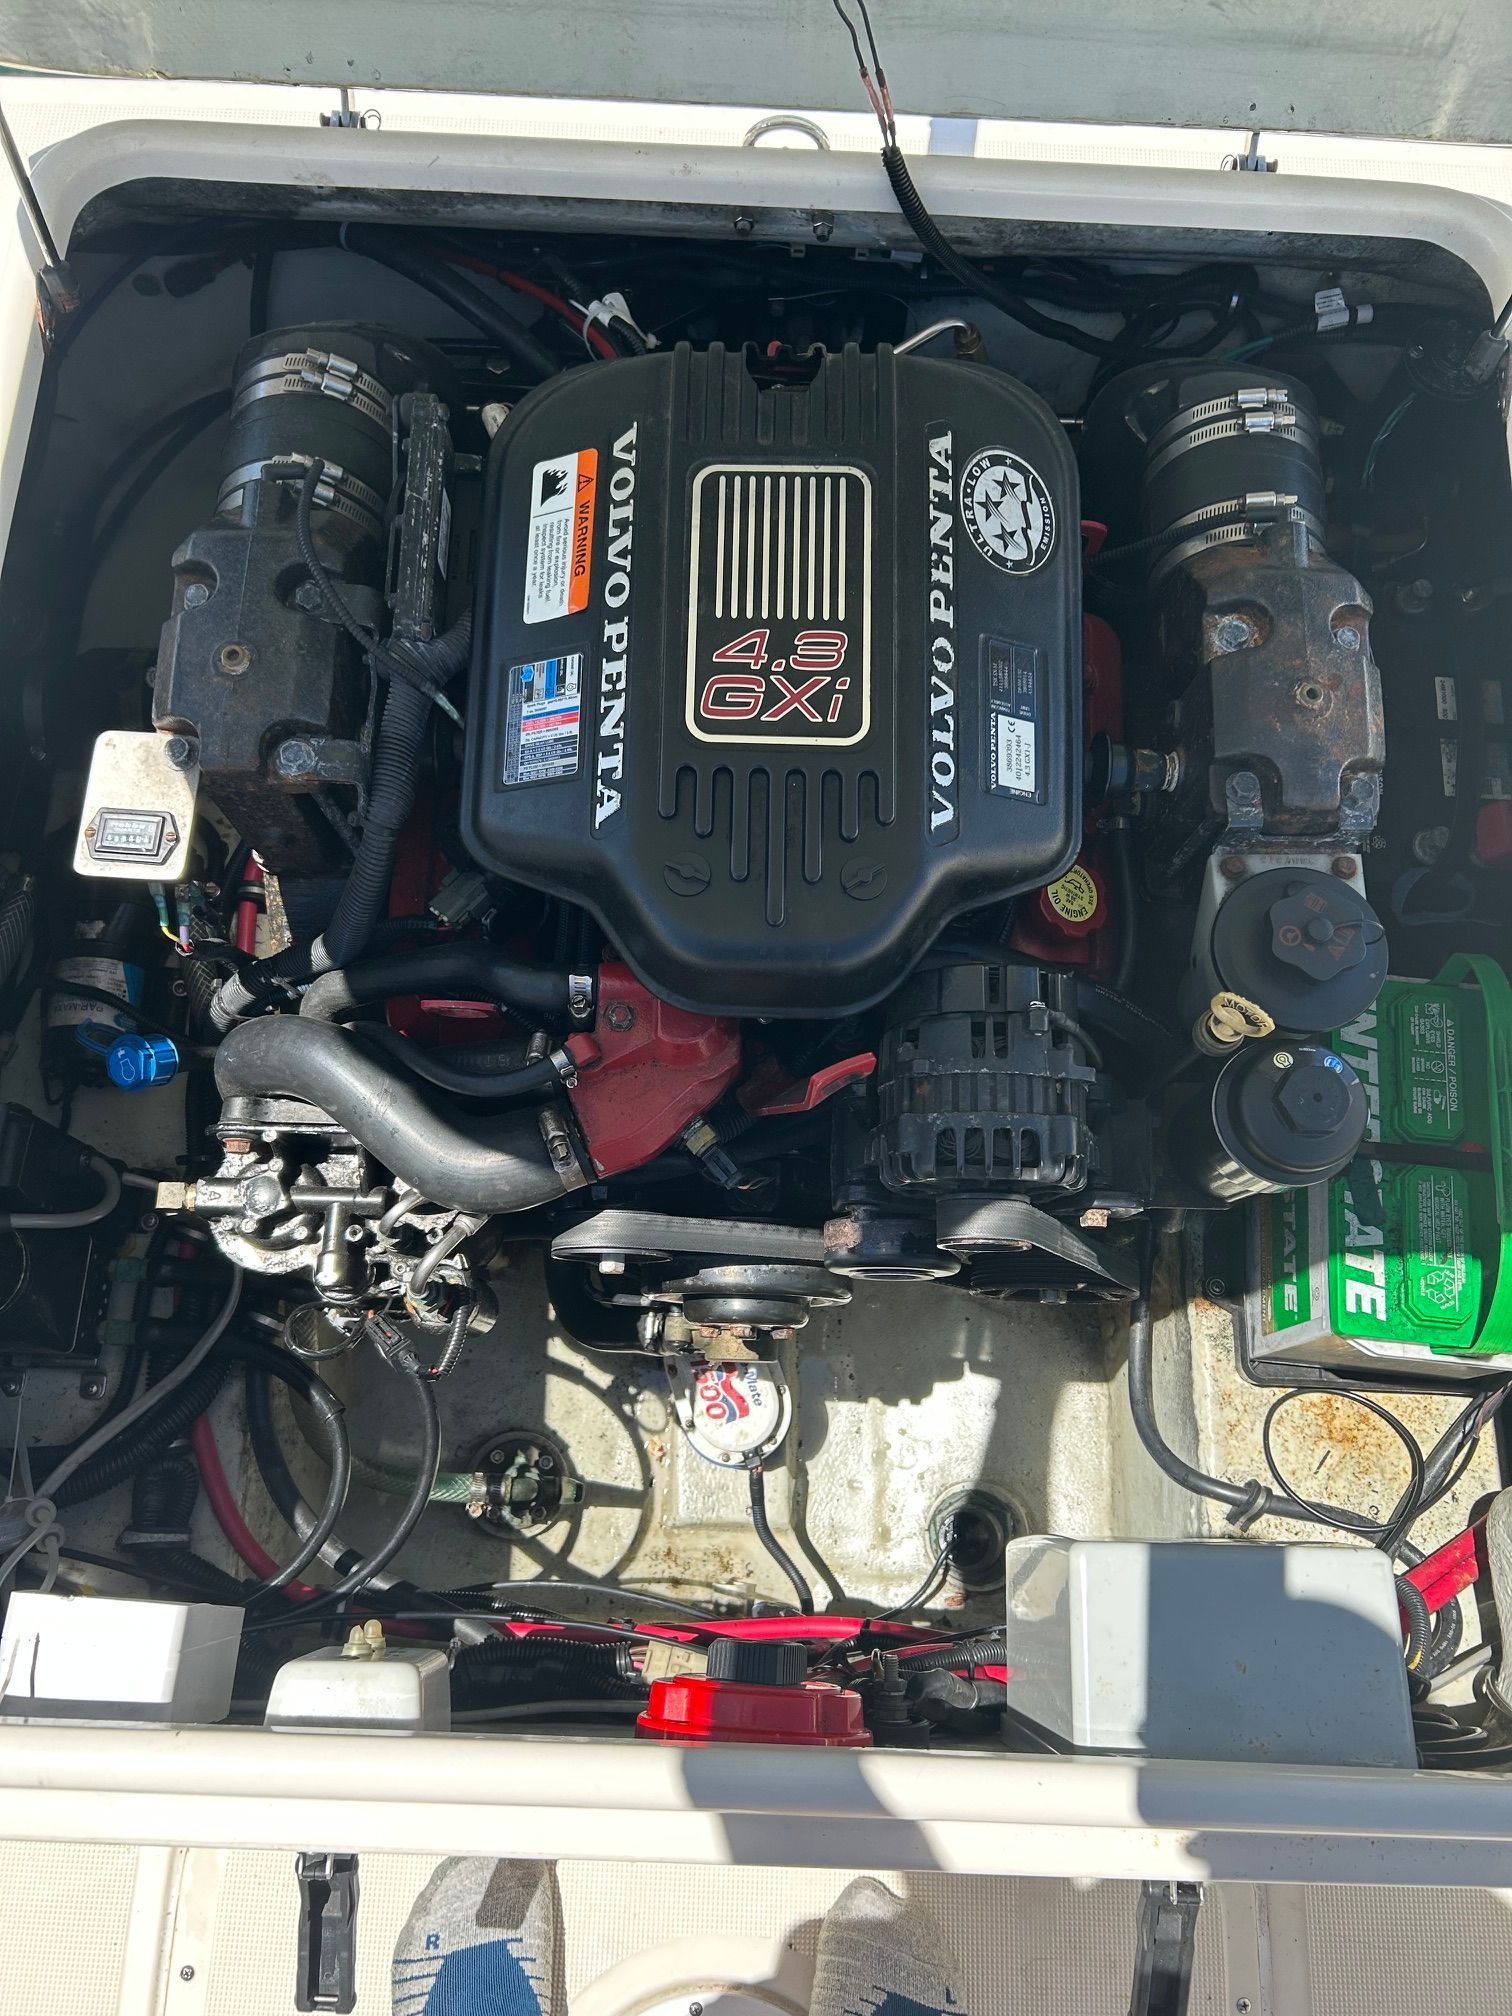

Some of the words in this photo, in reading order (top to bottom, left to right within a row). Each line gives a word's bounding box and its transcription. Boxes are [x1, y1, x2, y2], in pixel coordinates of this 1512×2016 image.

[604, 422, 638, 608] VOLVO
[929, 430, 953, 629] PENTA
[1040, 497, 1051, 551] EMISSION
[540, 523, 548, 546] Inspect
[547, 522, 555, 549] resulting
[574, 500, 591, 577] WARNING
[539, 547, 547, 570] system
[560, 561, 568, 579] injury
[545, 565, 553, 589] leaking
[713, 629, 848, 671] 4.3
[700, 675, 850, 722] GXi
[594, 616, 630, 830] PENTA
[930, 636, 954, 832] VOLVO
[1051, 889, 1061, 905] OIL
[1060, 904, 1088, 918] ENGINE
[1446, 1029, 1456, 1066] DANGER
[1448, 1076, 1458, 1112] POISON
[425, 1933, 440, 1950] R
